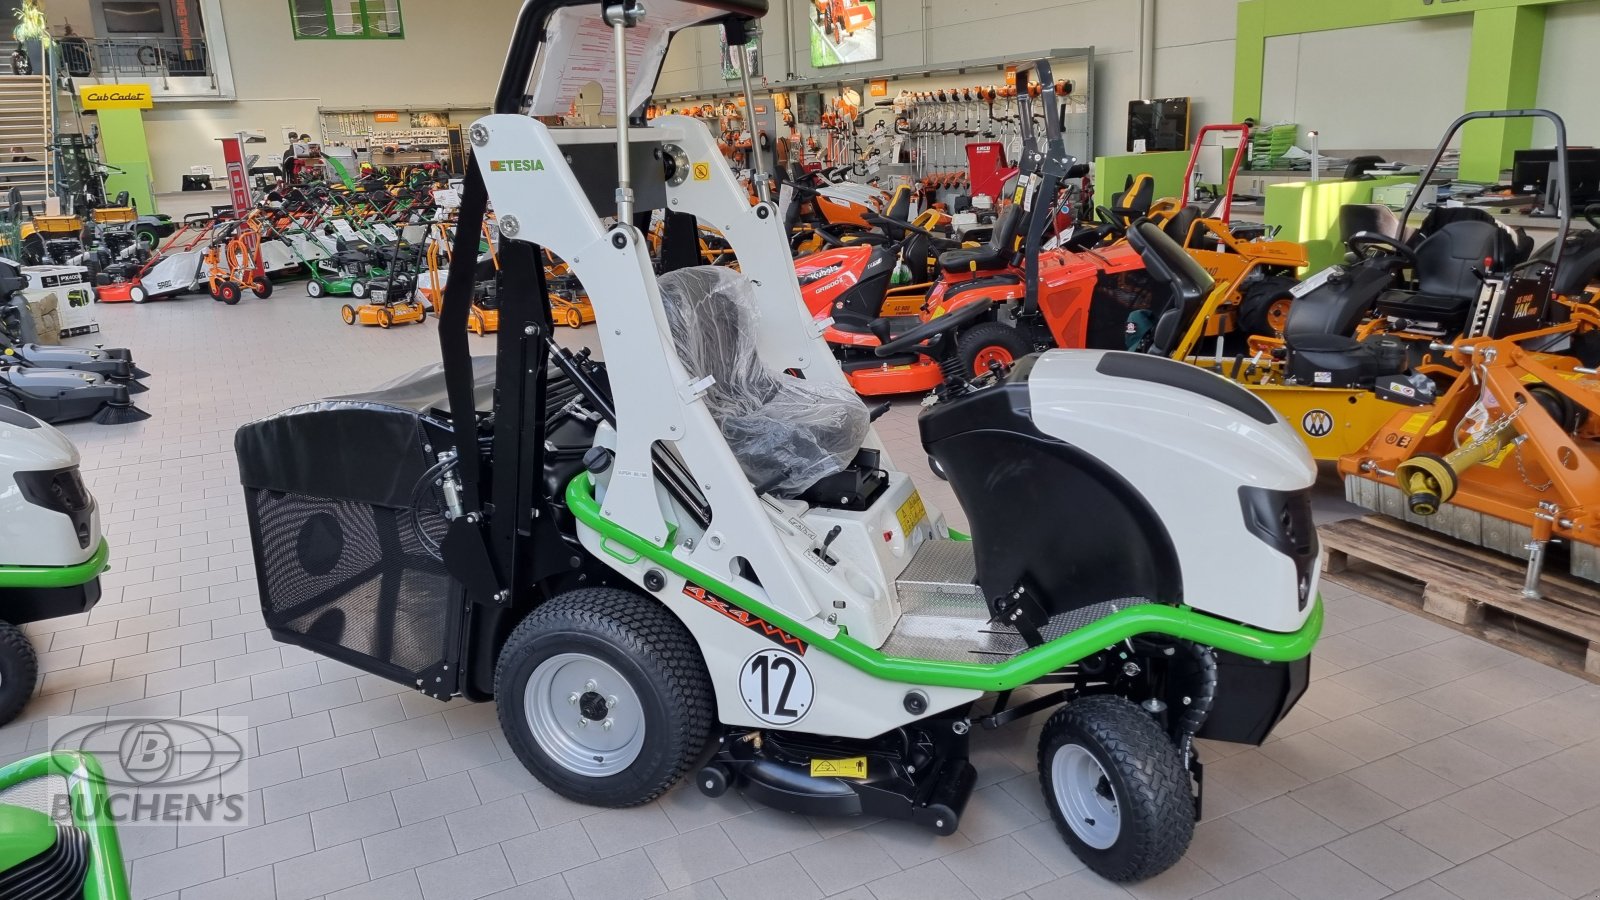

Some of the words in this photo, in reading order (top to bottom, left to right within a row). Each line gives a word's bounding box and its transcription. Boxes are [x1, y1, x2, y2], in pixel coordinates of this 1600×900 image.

[87, 92, 109, 102] Cub
[109, 92, 145, 101] Cadet
[490, 159, 544, 172] ETESIA
[810, 264, 839, 279] Kubota
[157, 279, 172, 289] SABO
[1513, 302, 1531, 319] YAK
[751, 654, 799, 718] 12
